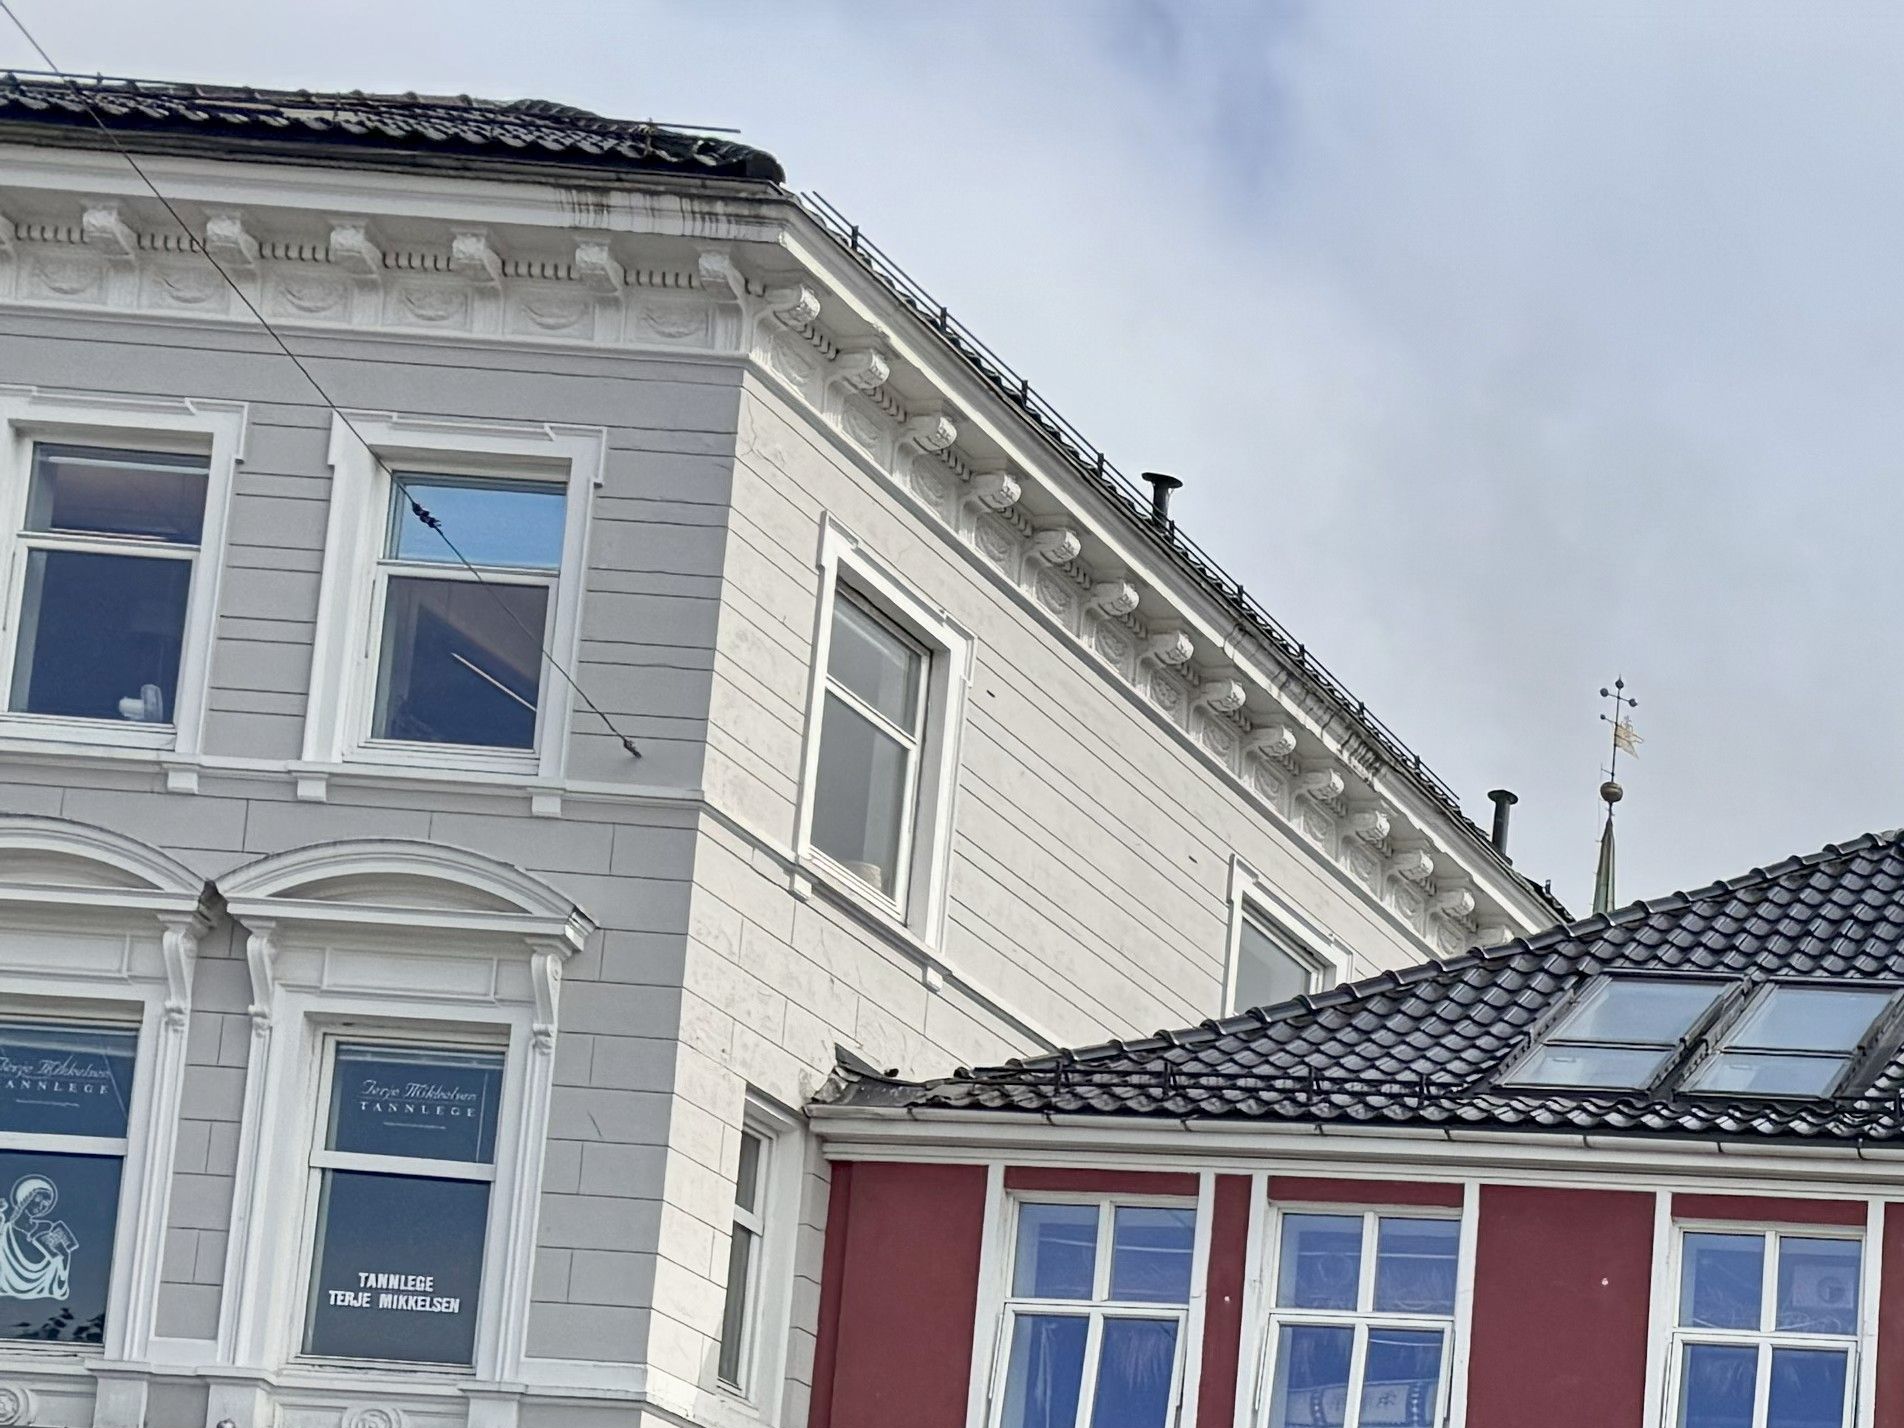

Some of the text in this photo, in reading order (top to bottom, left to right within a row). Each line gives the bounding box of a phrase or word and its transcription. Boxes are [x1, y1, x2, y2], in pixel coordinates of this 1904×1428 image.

[4, 1079, 109, 1095] ANNLEGE
[360, 1101, 476, 1117] TANNLEGE
[358, 1272, 434, 1292] TANNLEGE
[328, 1290, 460, 1313] TERJE MIKKELSEN
